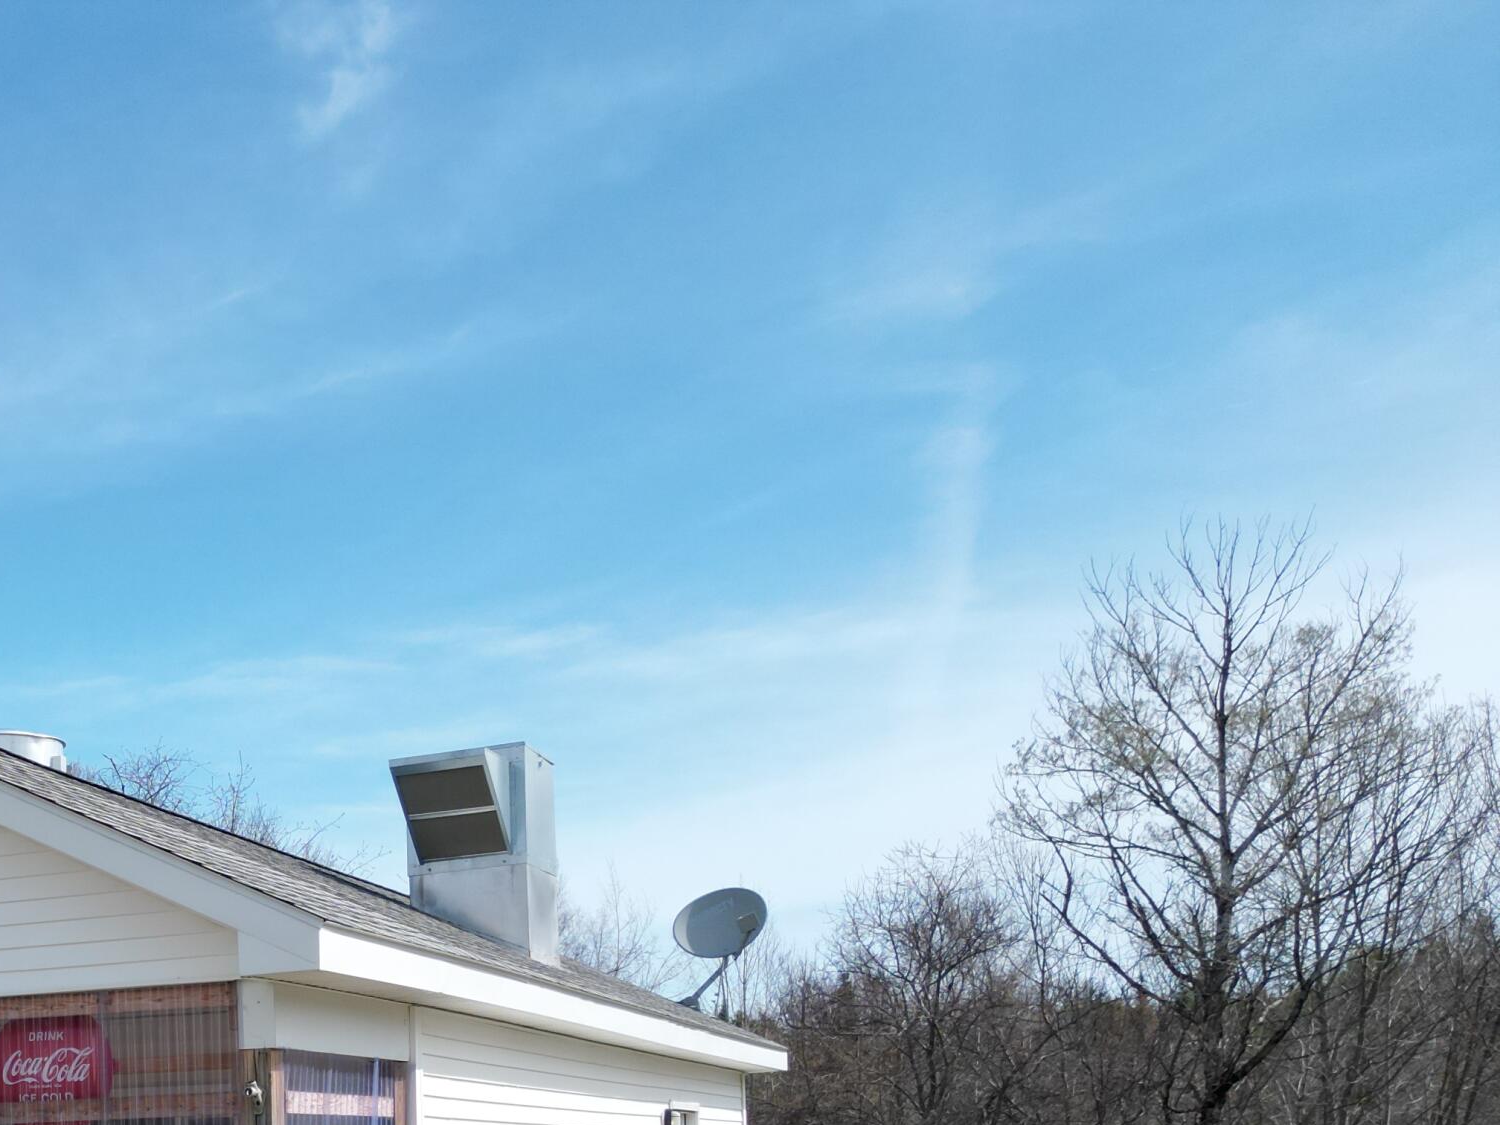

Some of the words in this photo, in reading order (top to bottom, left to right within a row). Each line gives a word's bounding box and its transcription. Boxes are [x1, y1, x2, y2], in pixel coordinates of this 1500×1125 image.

[28, 1031, 64, 1042] DRINK
[2, 1046, 94, 1086] Coca-Cola
[19, 1093, 36, 1103] ICE
